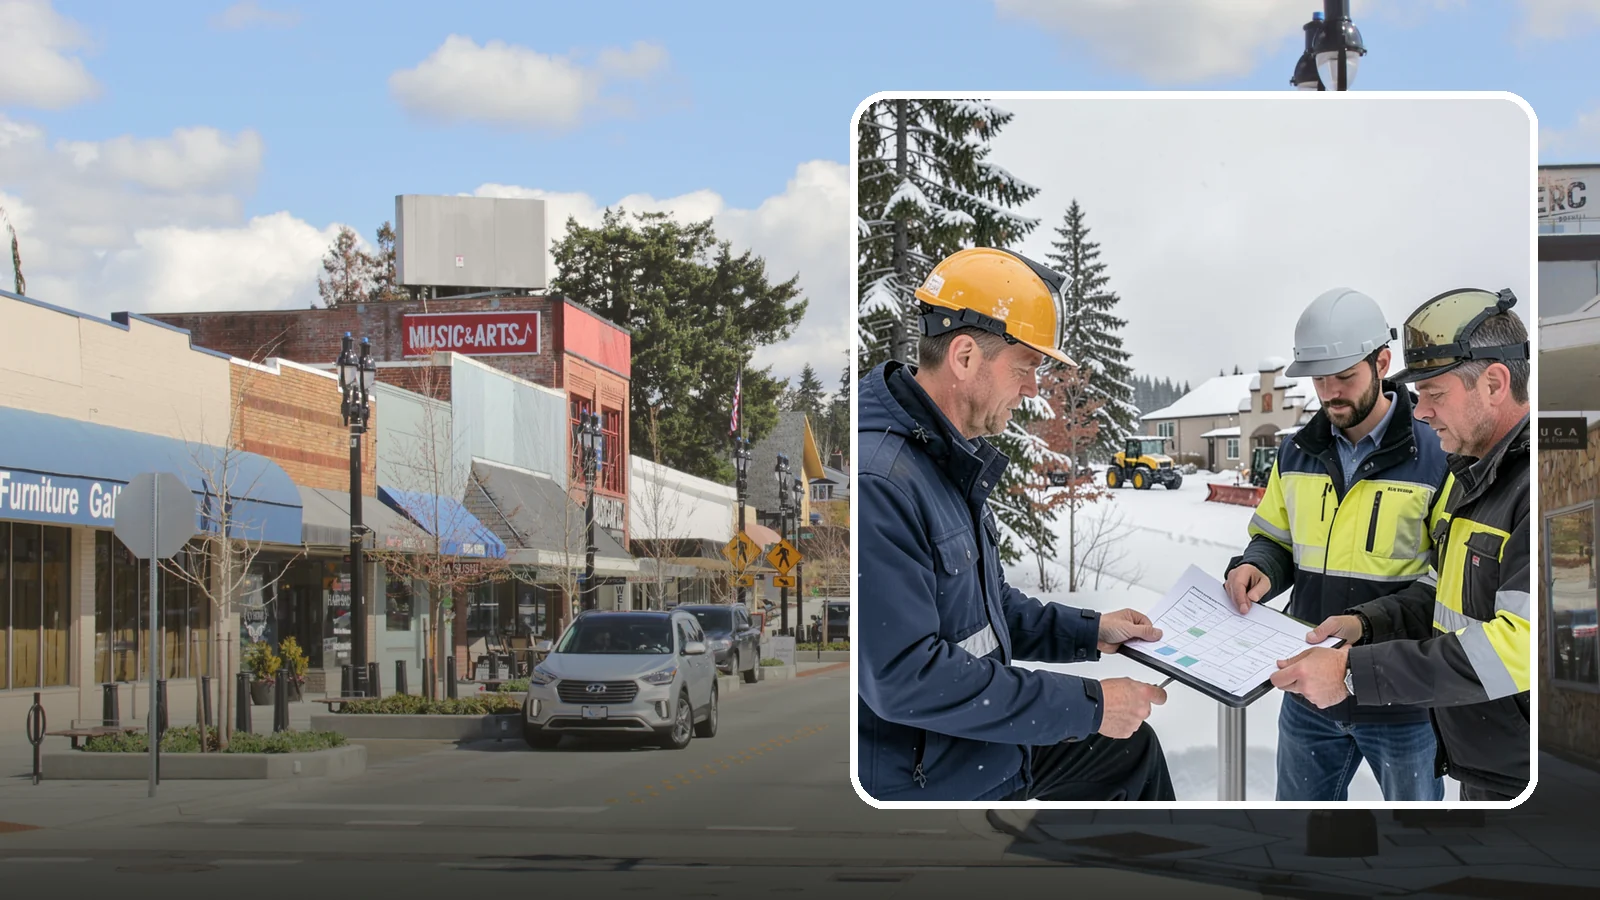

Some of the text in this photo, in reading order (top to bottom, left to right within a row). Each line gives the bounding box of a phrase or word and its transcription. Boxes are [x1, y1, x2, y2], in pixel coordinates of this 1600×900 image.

[409, 323, 520, 349] MUSIC&ARTS
[0, 472, 122, 519] Furniture Gal
